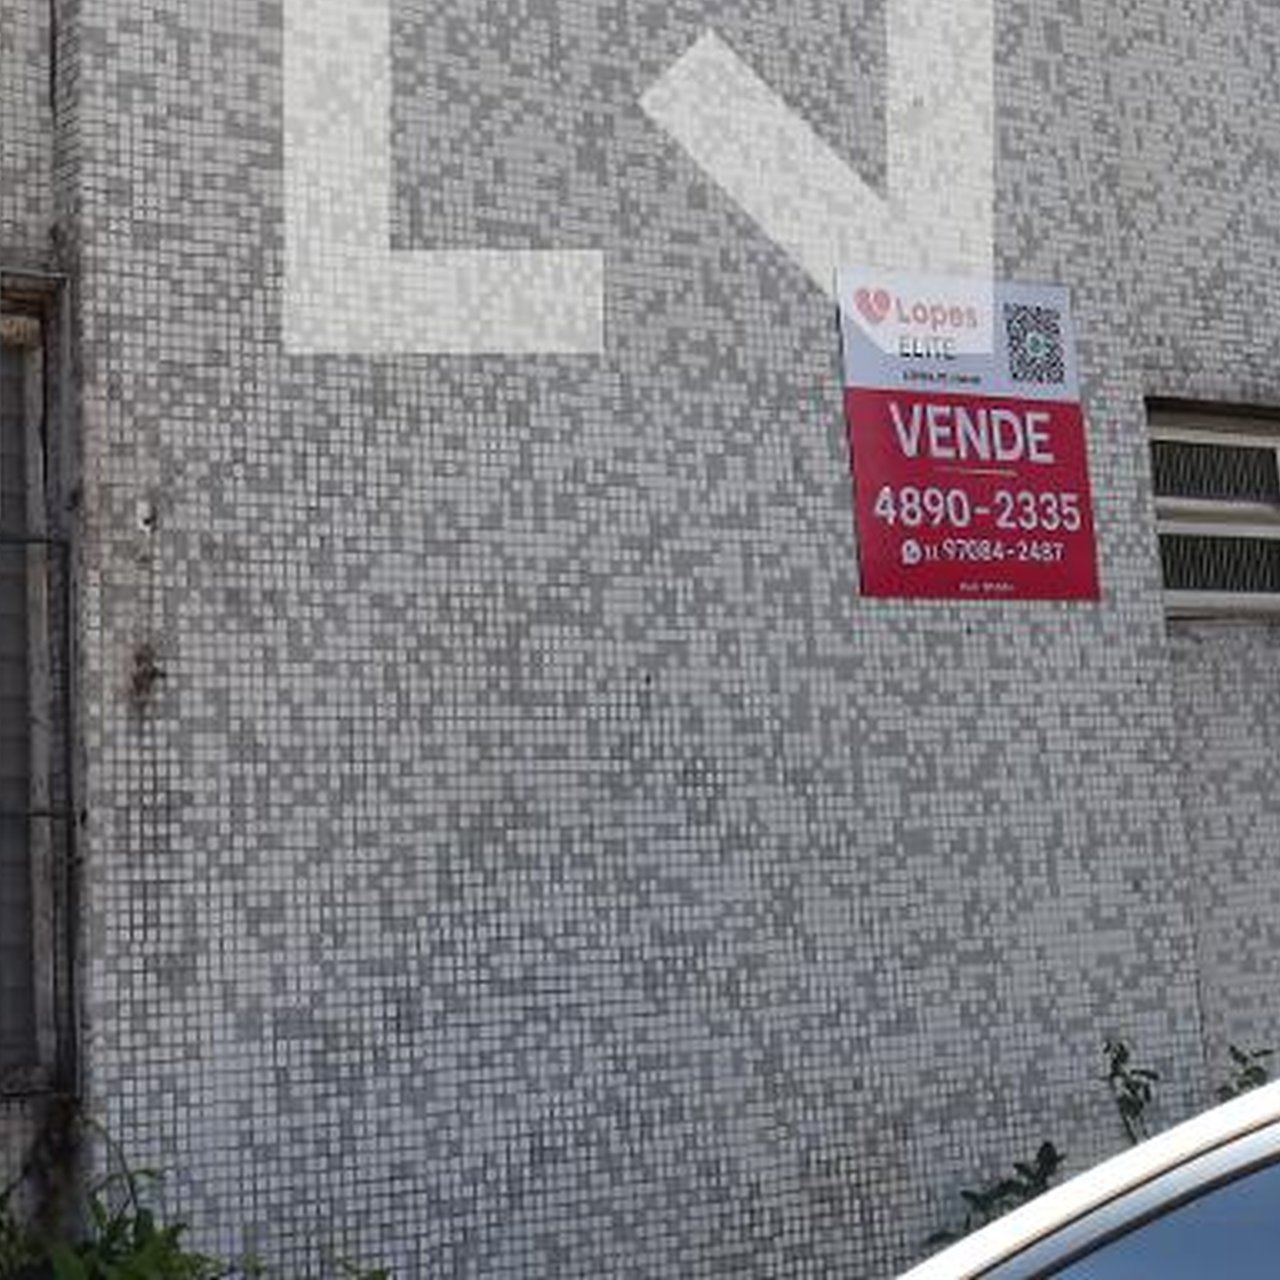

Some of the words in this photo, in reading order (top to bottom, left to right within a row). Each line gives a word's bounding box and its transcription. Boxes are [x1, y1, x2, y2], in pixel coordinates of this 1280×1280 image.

[895, 296, 979, 332] Lopes
[898, 336, 958, 361] ELITE
[888, 401, 1056, 465] VENDE
[874, 485, 1081, 531] 4890-2335
